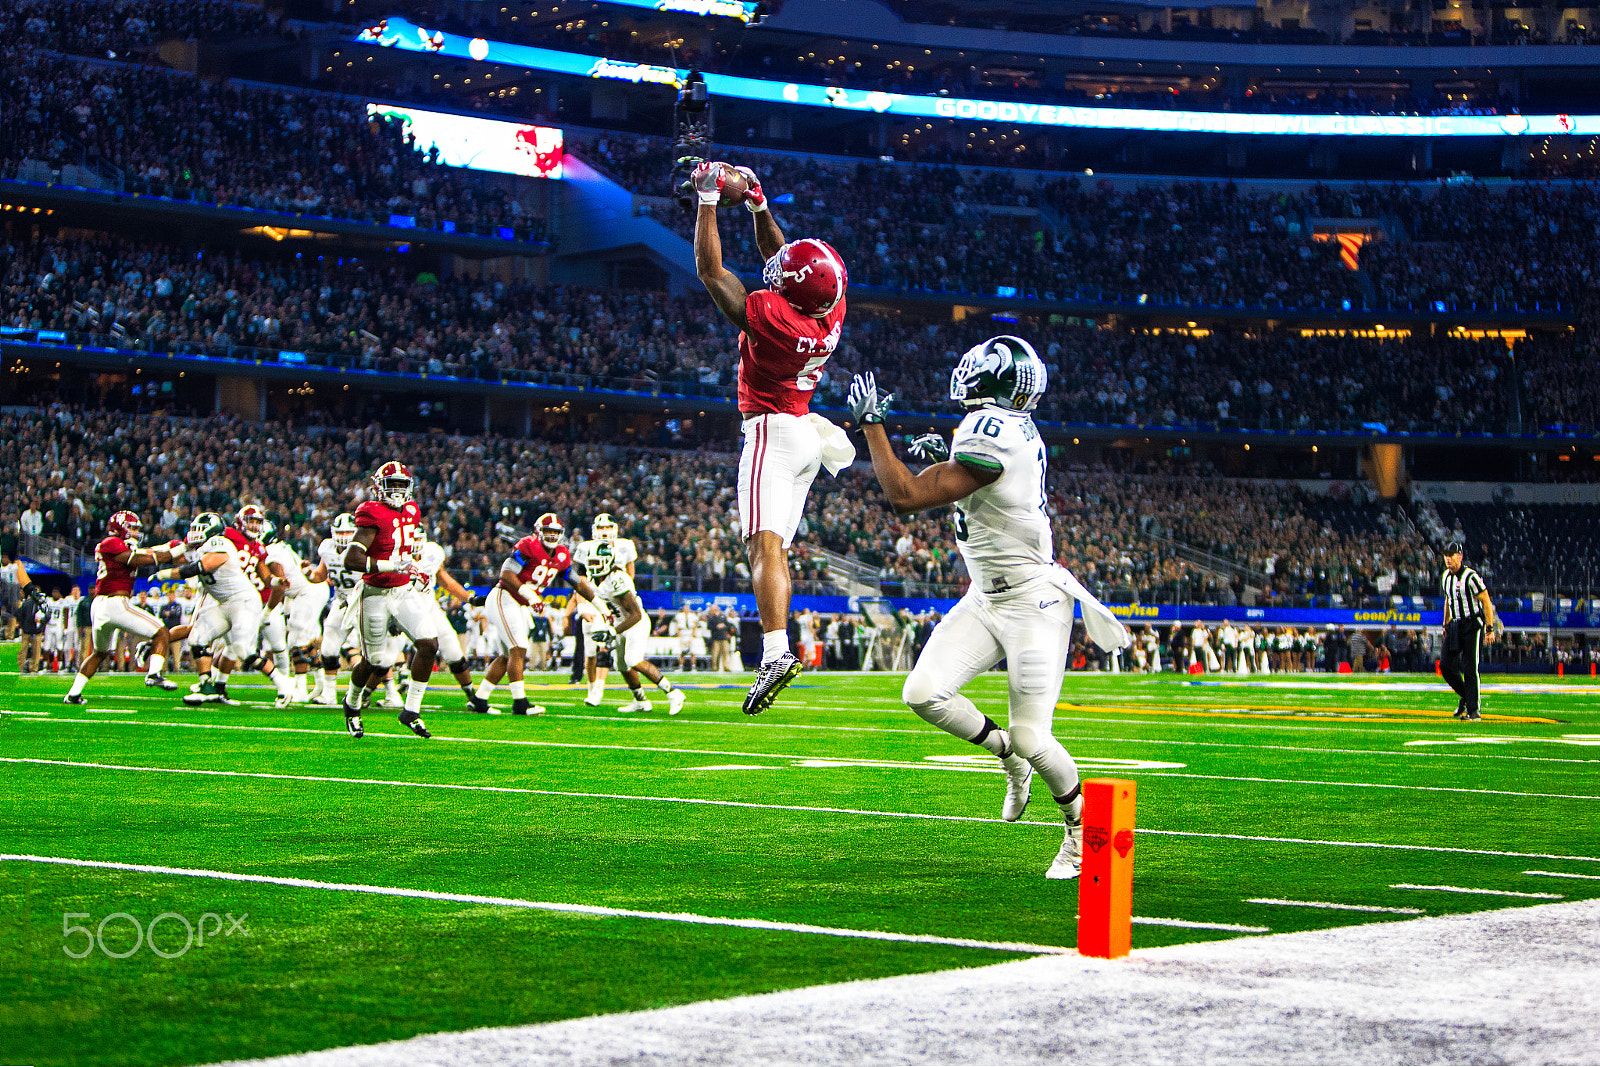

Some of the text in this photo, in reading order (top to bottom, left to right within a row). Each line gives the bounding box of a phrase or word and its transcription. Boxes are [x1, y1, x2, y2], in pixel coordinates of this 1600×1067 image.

[935, 98, 1098, 126] GOODYEAR
[1330, 115, 1458, 135] CLASSIC
[795, 264, 814, 283] 5
[972, 415, 1005, 438] 16
[390, 524, 417, 560] 15
[531, 565, 559, 596] 93
[1108, 602, 1159, 618] OODYEAR
[1353, 608, 1421, 625] GOODYEAR
